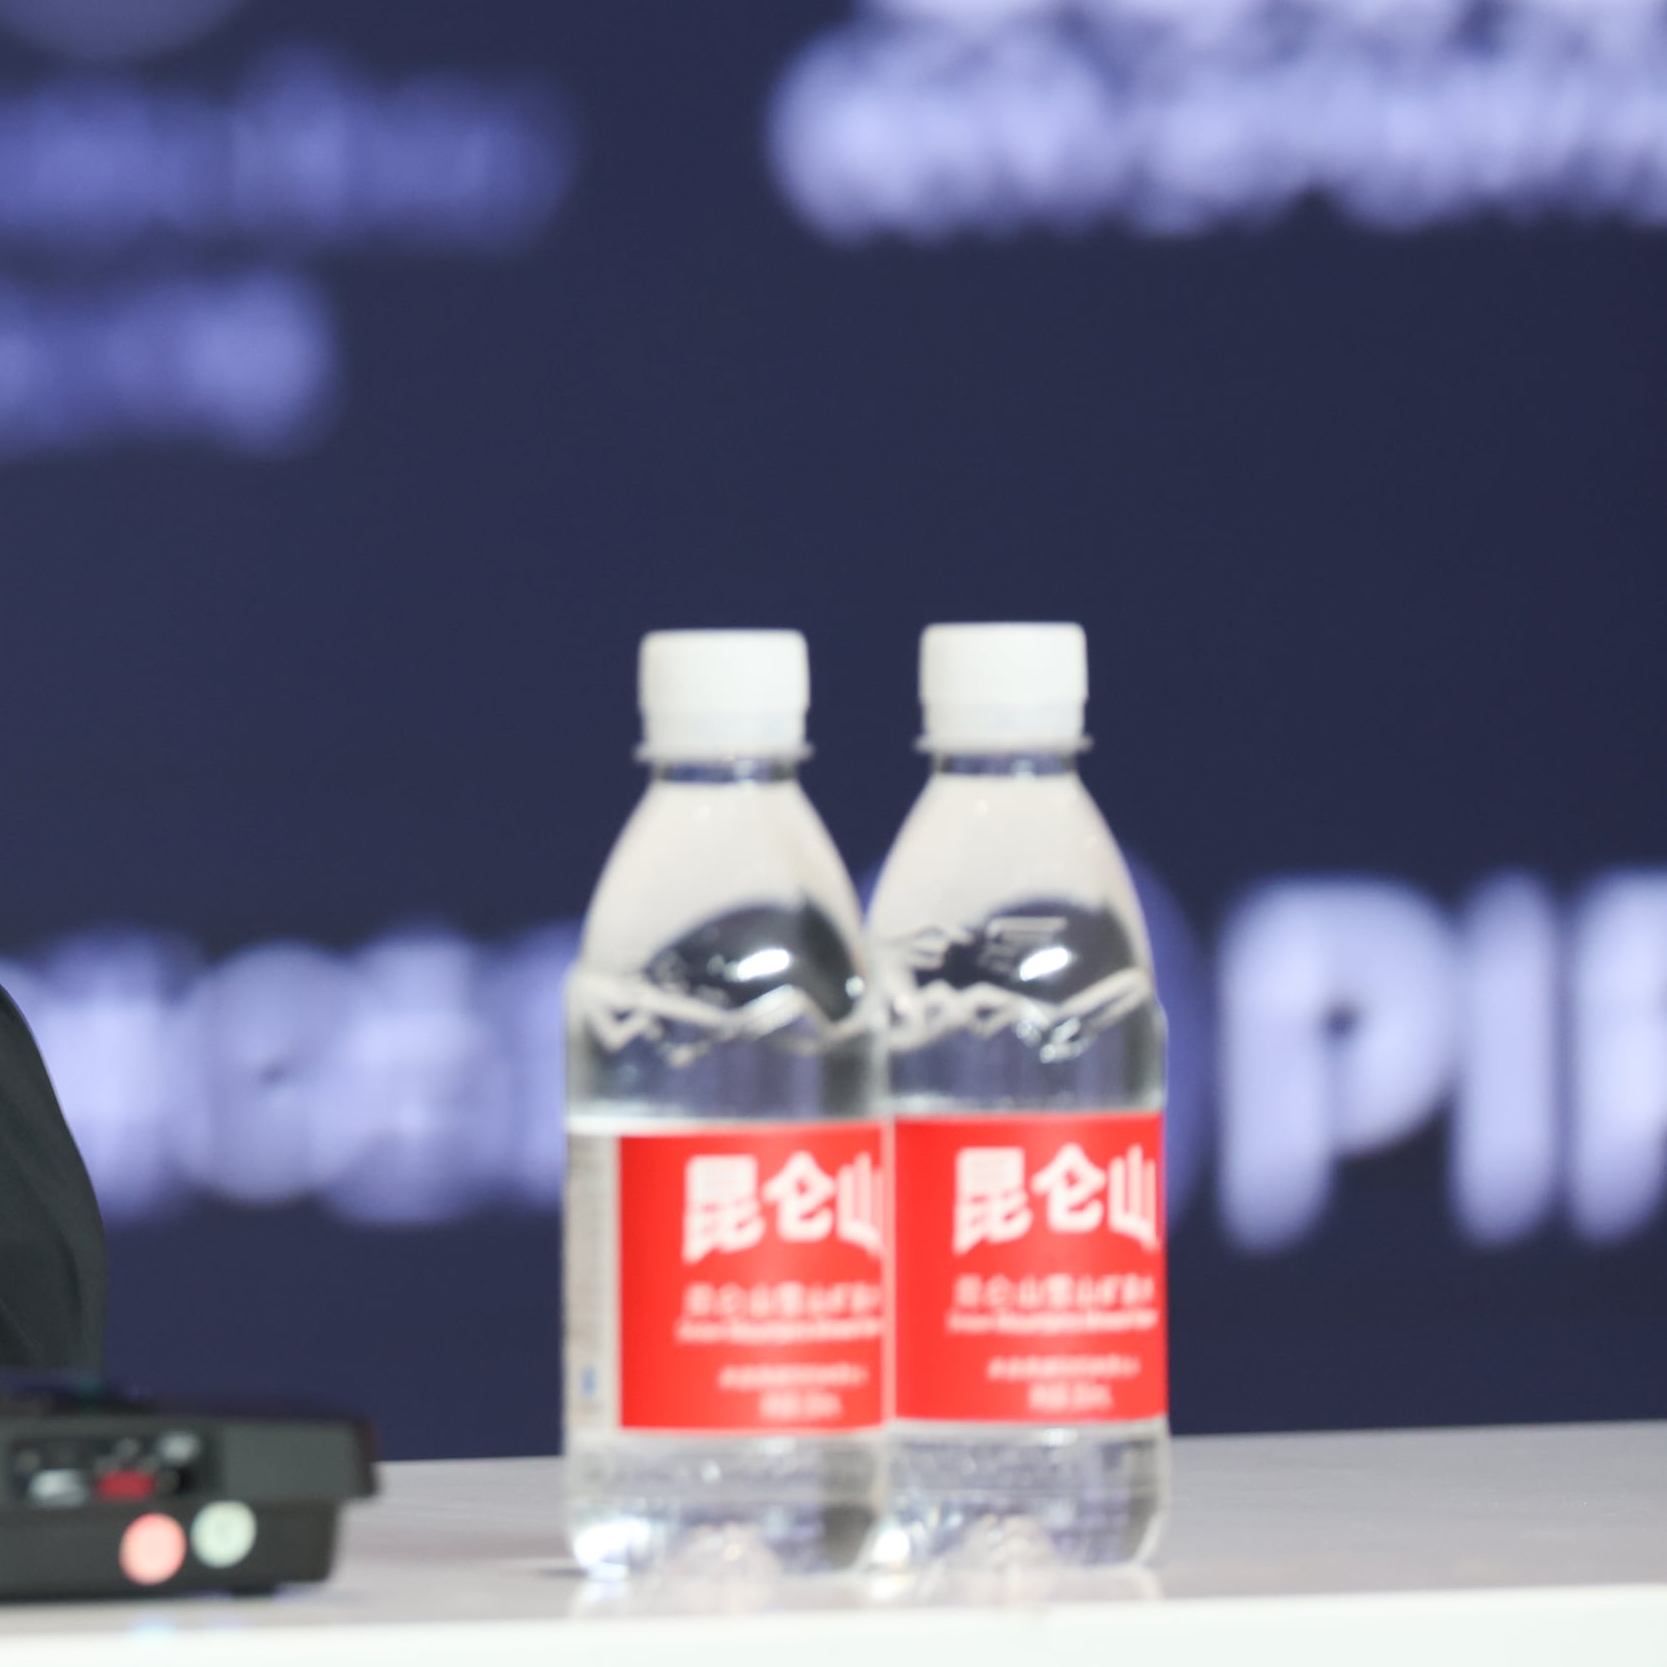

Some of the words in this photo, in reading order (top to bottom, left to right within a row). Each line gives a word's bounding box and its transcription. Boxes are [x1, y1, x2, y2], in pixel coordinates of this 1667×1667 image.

[682, 1151, 883, 1264] 昆仑山
[953, 1143, 1159, 1255] 昆仑山
